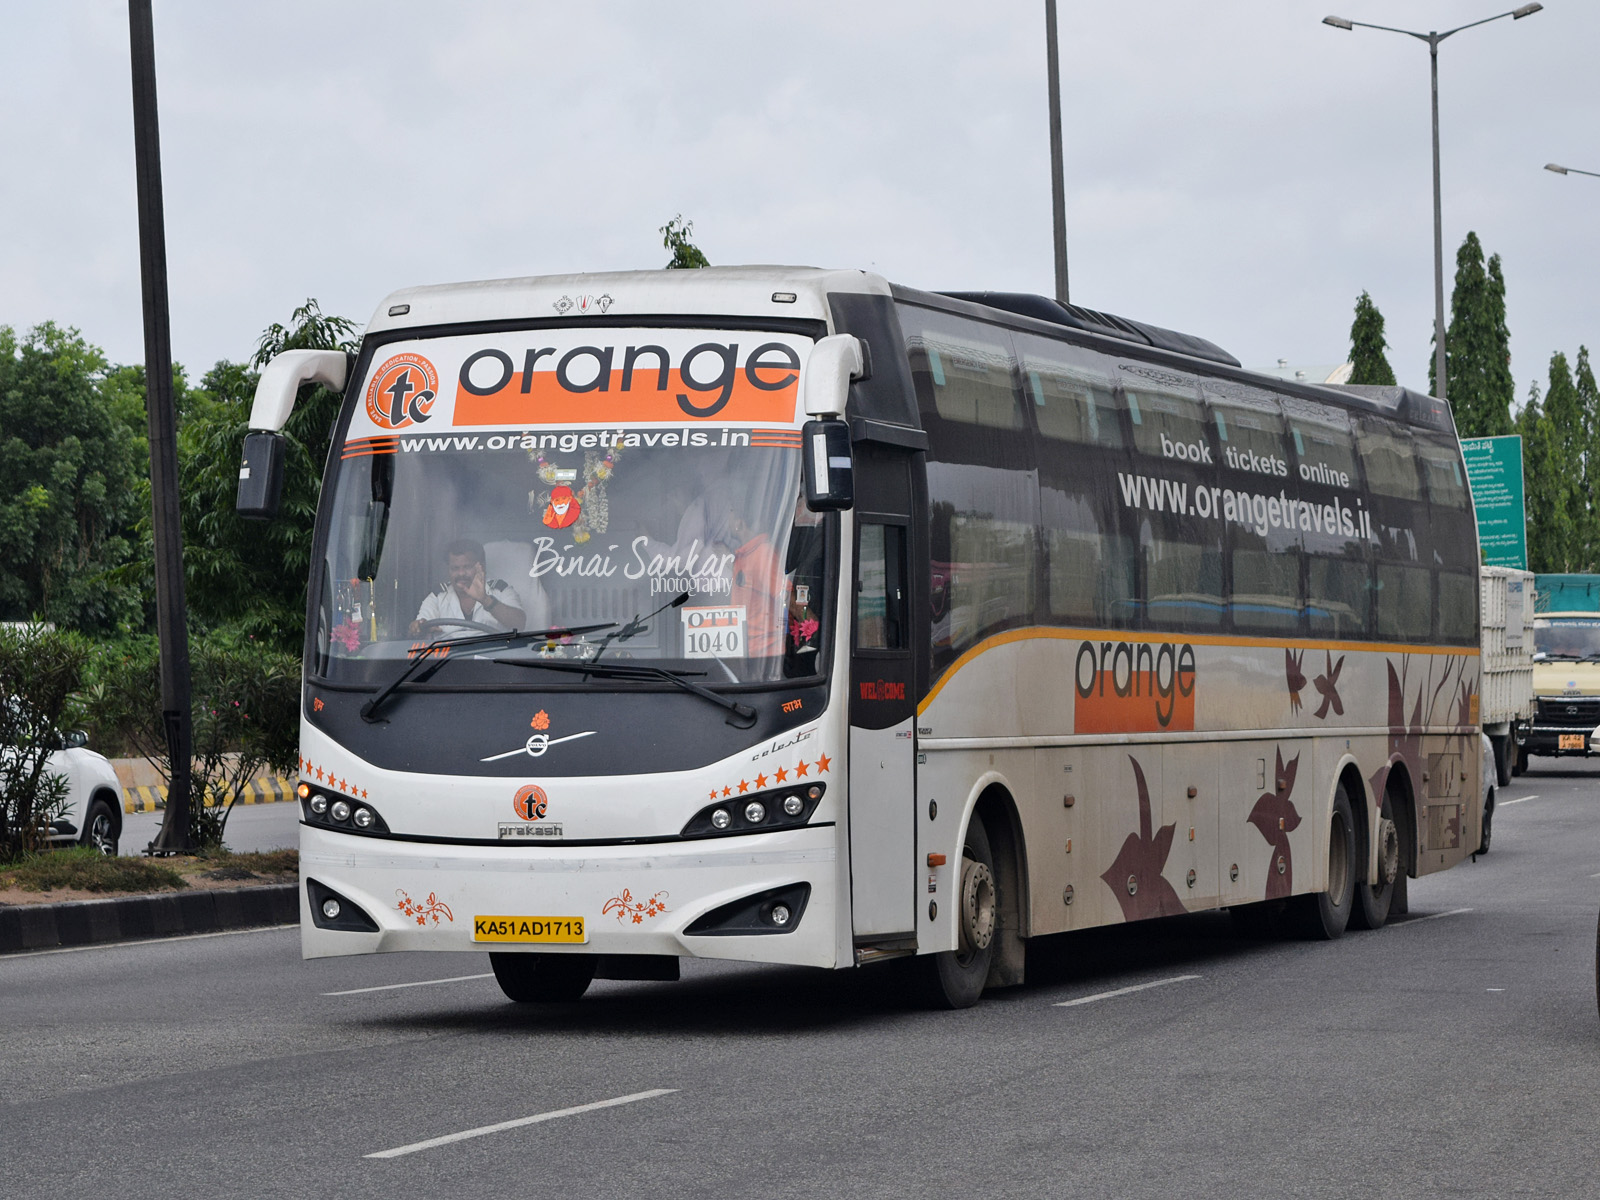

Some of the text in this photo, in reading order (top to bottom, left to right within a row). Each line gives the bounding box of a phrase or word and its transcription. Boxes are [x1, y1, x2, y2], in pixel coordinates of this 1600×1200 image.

[381, 355, 418, 371] DEDICATION
[421, 361, 436, 385] PASSION
[459, 342, 801, 418] orange
[400, 428, 750, 453] www.orangetravels.in
[1159, 432, 1350, 489] book tickets online
[687, 611, 738, 628] OTT
[687, 631, 739, 653] 1040
[1075, 640, 1196, 727] orange
[781, 698, 803, 713] लाभ
[499, 823, 563, 840] prakash
[475, 920, 584, 936] KA51AD1713
